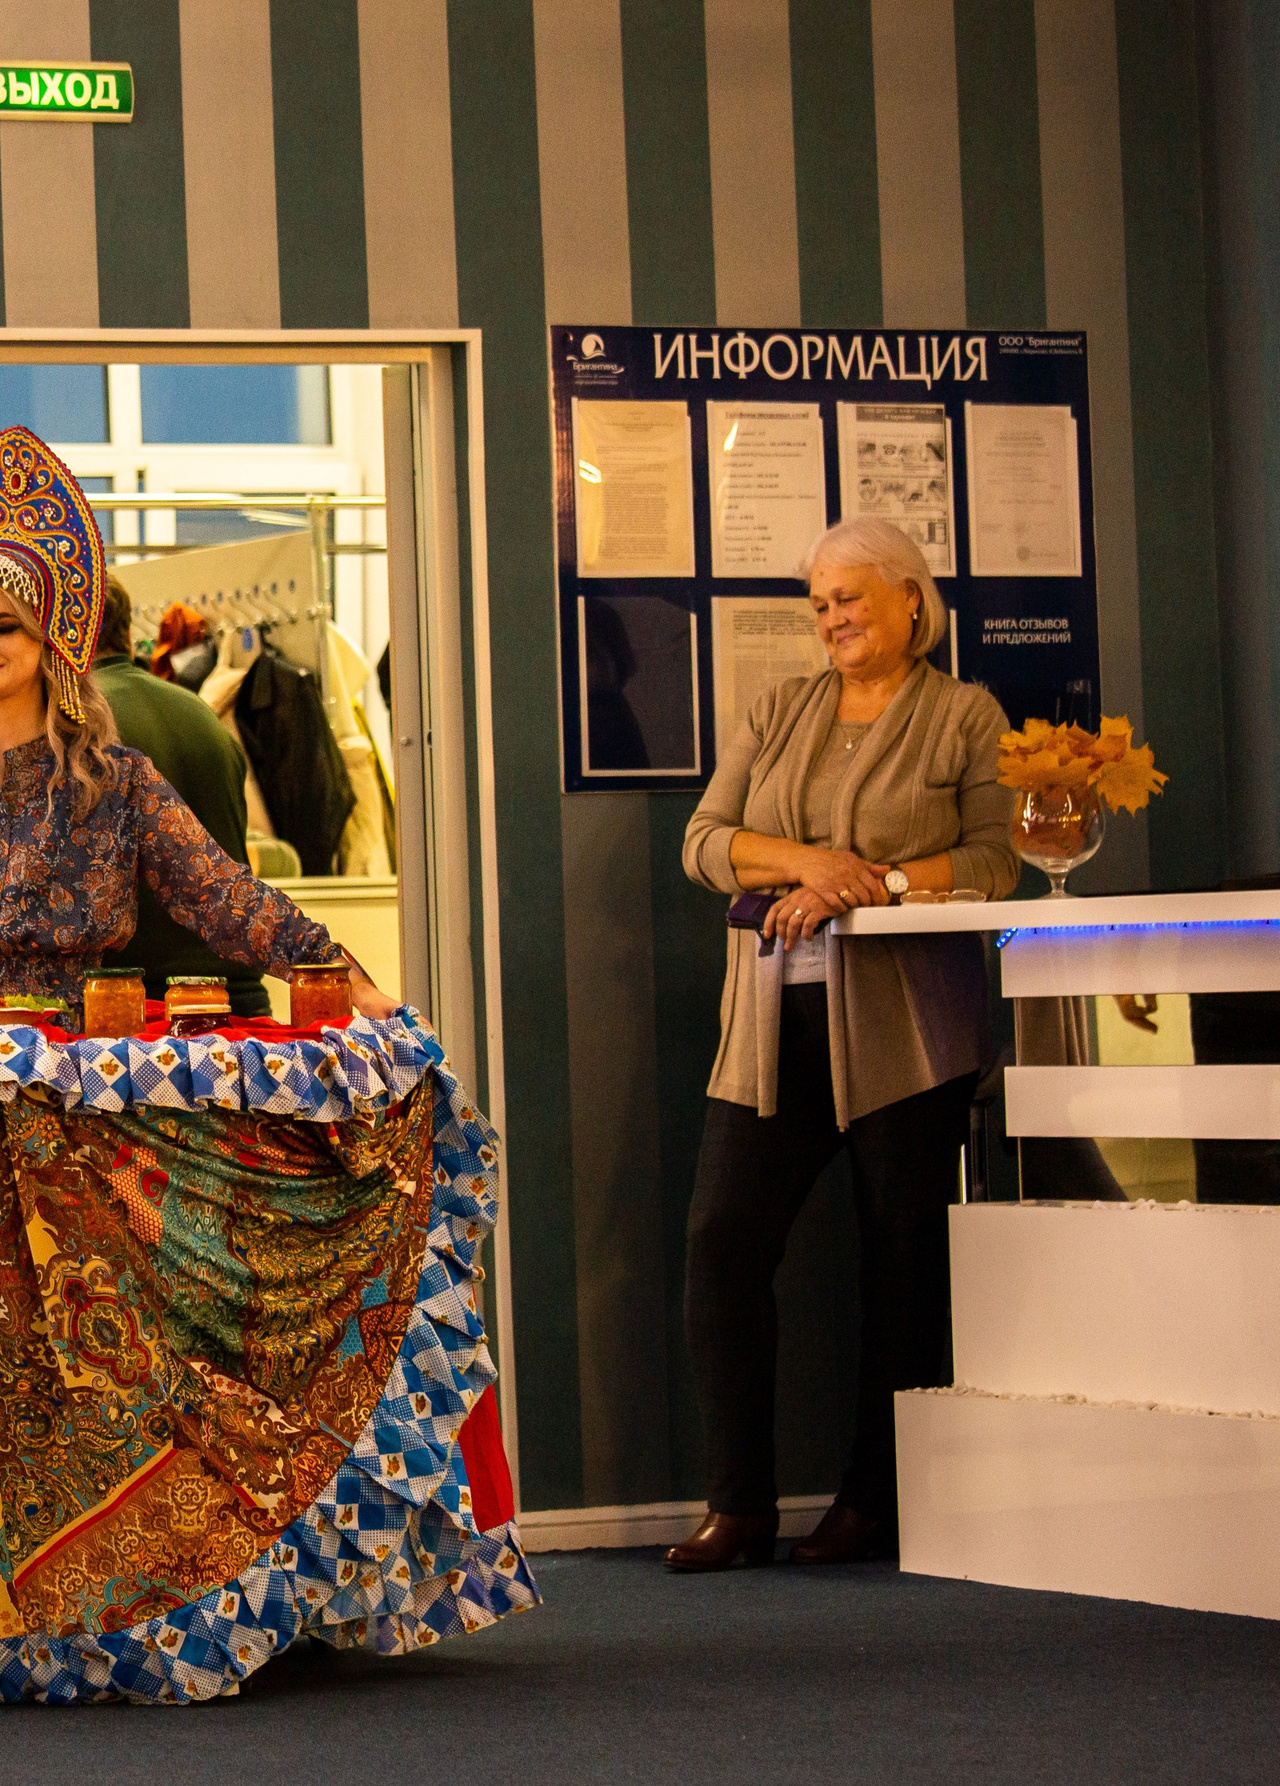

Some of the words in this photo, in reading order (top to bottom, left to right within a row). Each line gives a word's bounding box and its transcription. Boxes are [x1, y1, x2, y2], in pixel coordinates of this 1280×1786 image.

[998, 336, 1024, 346] ООО
[653, 332, 988, 391] ИНФОРМАЦИЯ
[984, 618, 1018, 630] КНИГА
[1019, 618, 1069, 630] ОТЗЫВОВ
[982, 633, 991, 644] И
[992, 630, 1071, 645] ПРЕДЛОЖЕНИЙ
